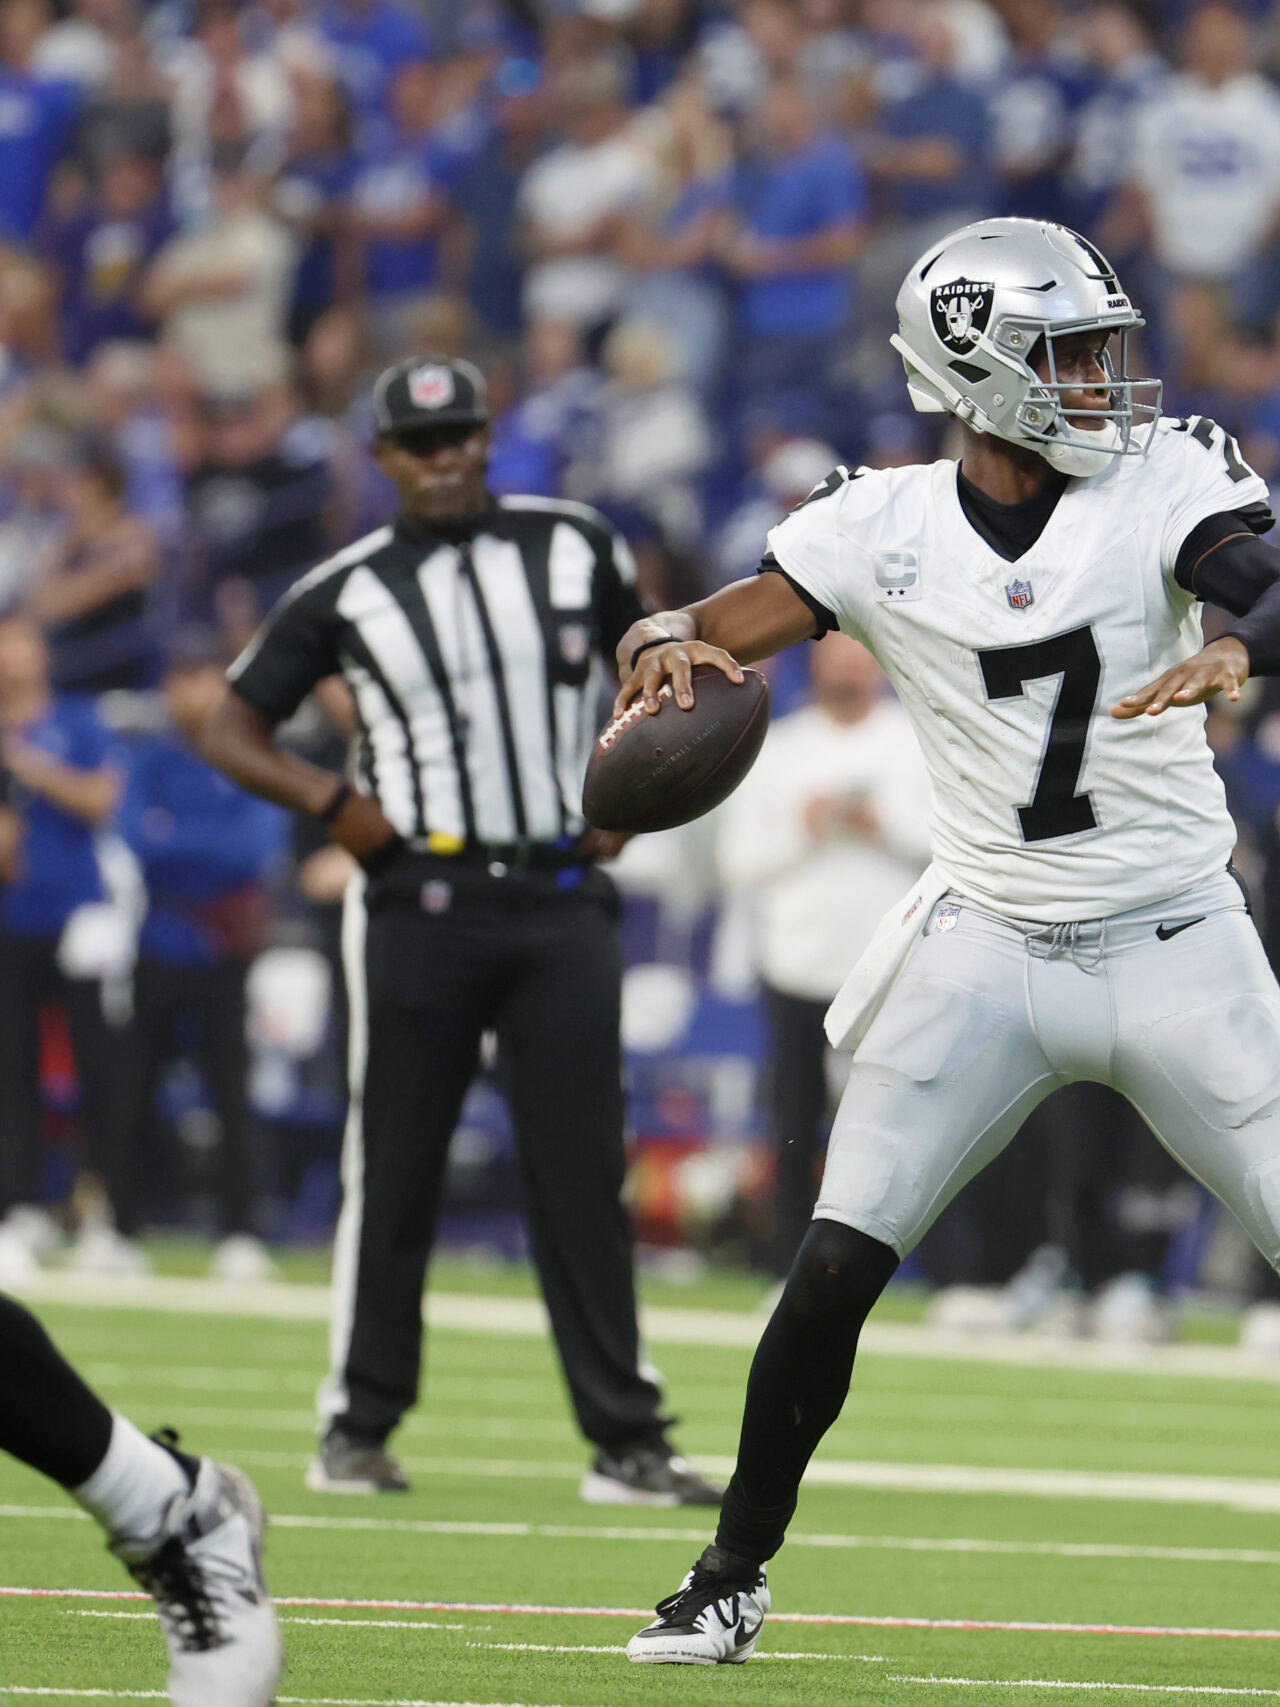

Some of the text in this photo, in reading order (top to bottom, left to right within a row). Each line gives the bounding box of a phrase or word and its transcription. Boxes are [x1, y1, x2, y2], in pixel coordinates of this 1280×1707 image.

[936, 283, 988, 297] RAIDERS
[1107, 298, 1129, 309] RAIDE
[1190, 416, 1253, 484] 7
[875, 552, 917, 589] C
[1011, 593, 1031, 608] NFL
[971, 620, 1106, 848] 7
